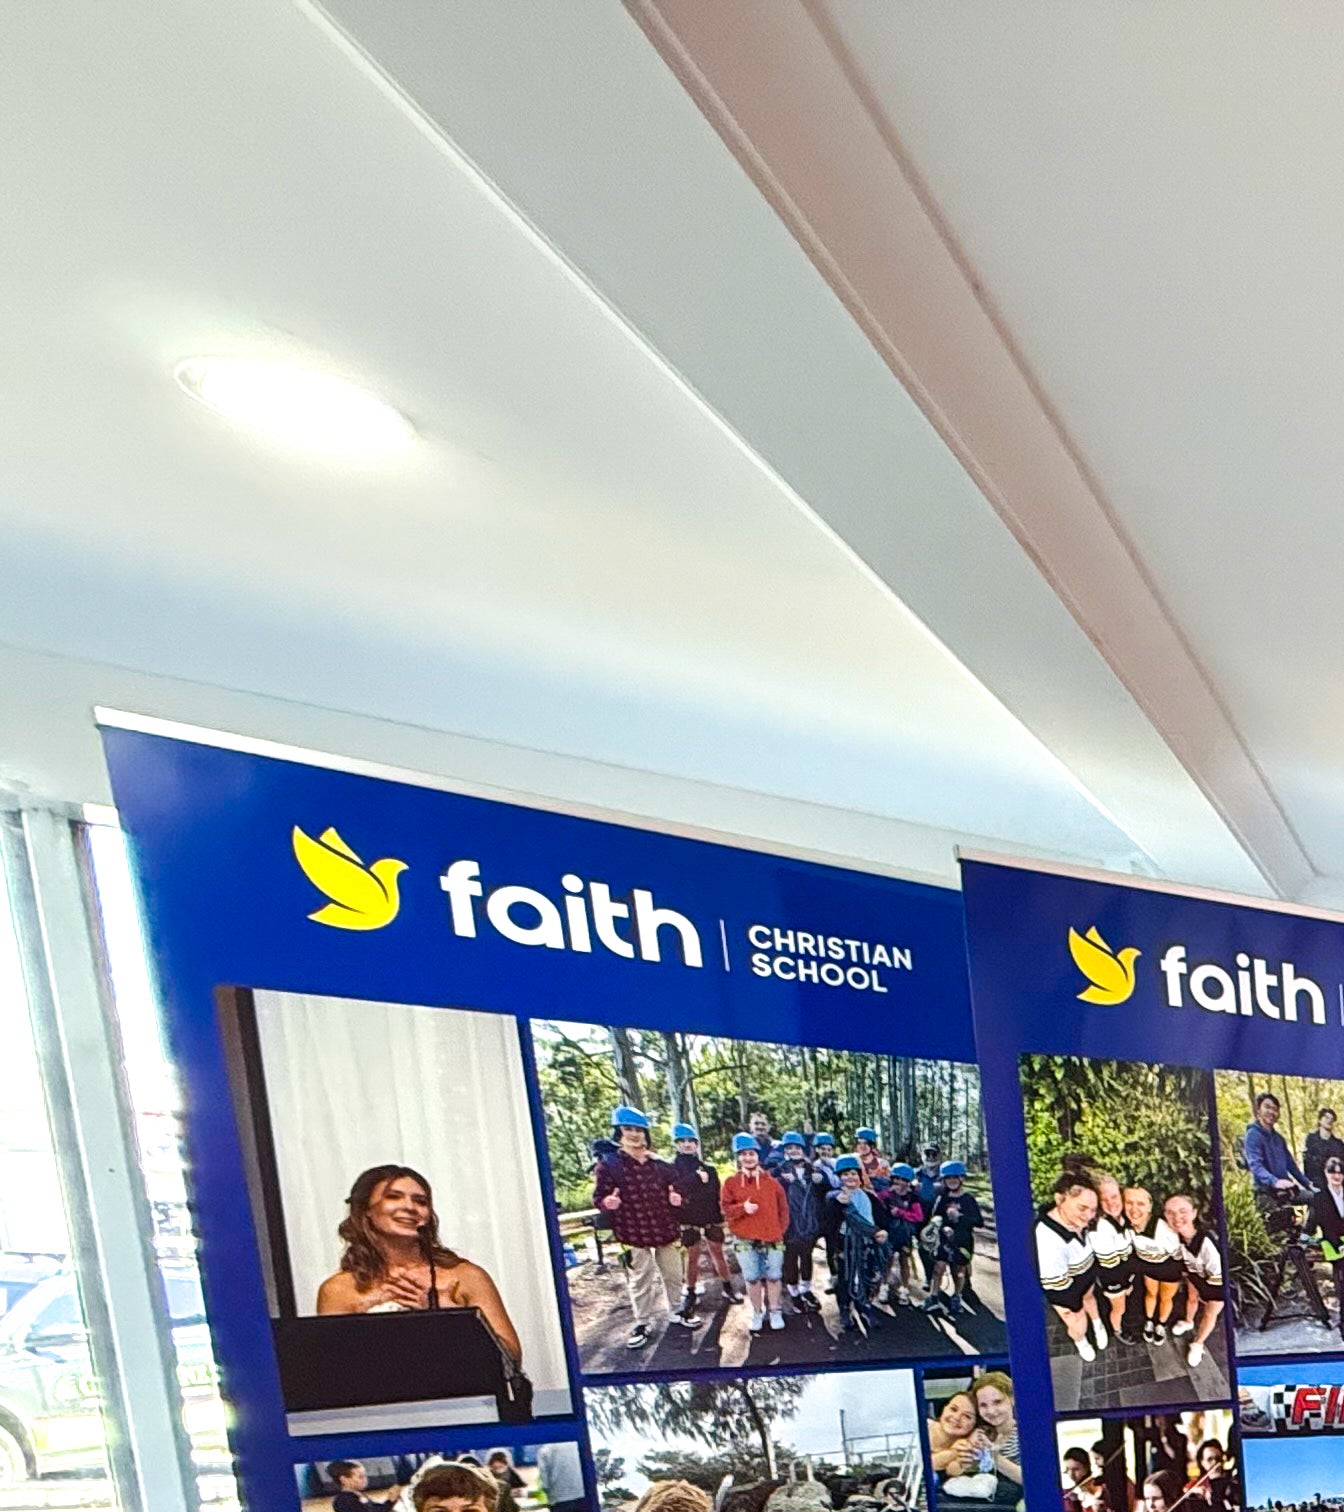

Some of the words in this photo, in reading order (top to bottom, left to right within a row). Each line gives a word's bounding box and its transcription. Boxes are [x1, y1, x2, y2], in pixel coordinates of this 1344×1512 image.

[440, 860, 702, 968] faith
[748, 924, 913, 972] CHRISTIAN
[751, 950, 889, 993] SCHOOL
[1161, 946, 1325, 1024] faith
